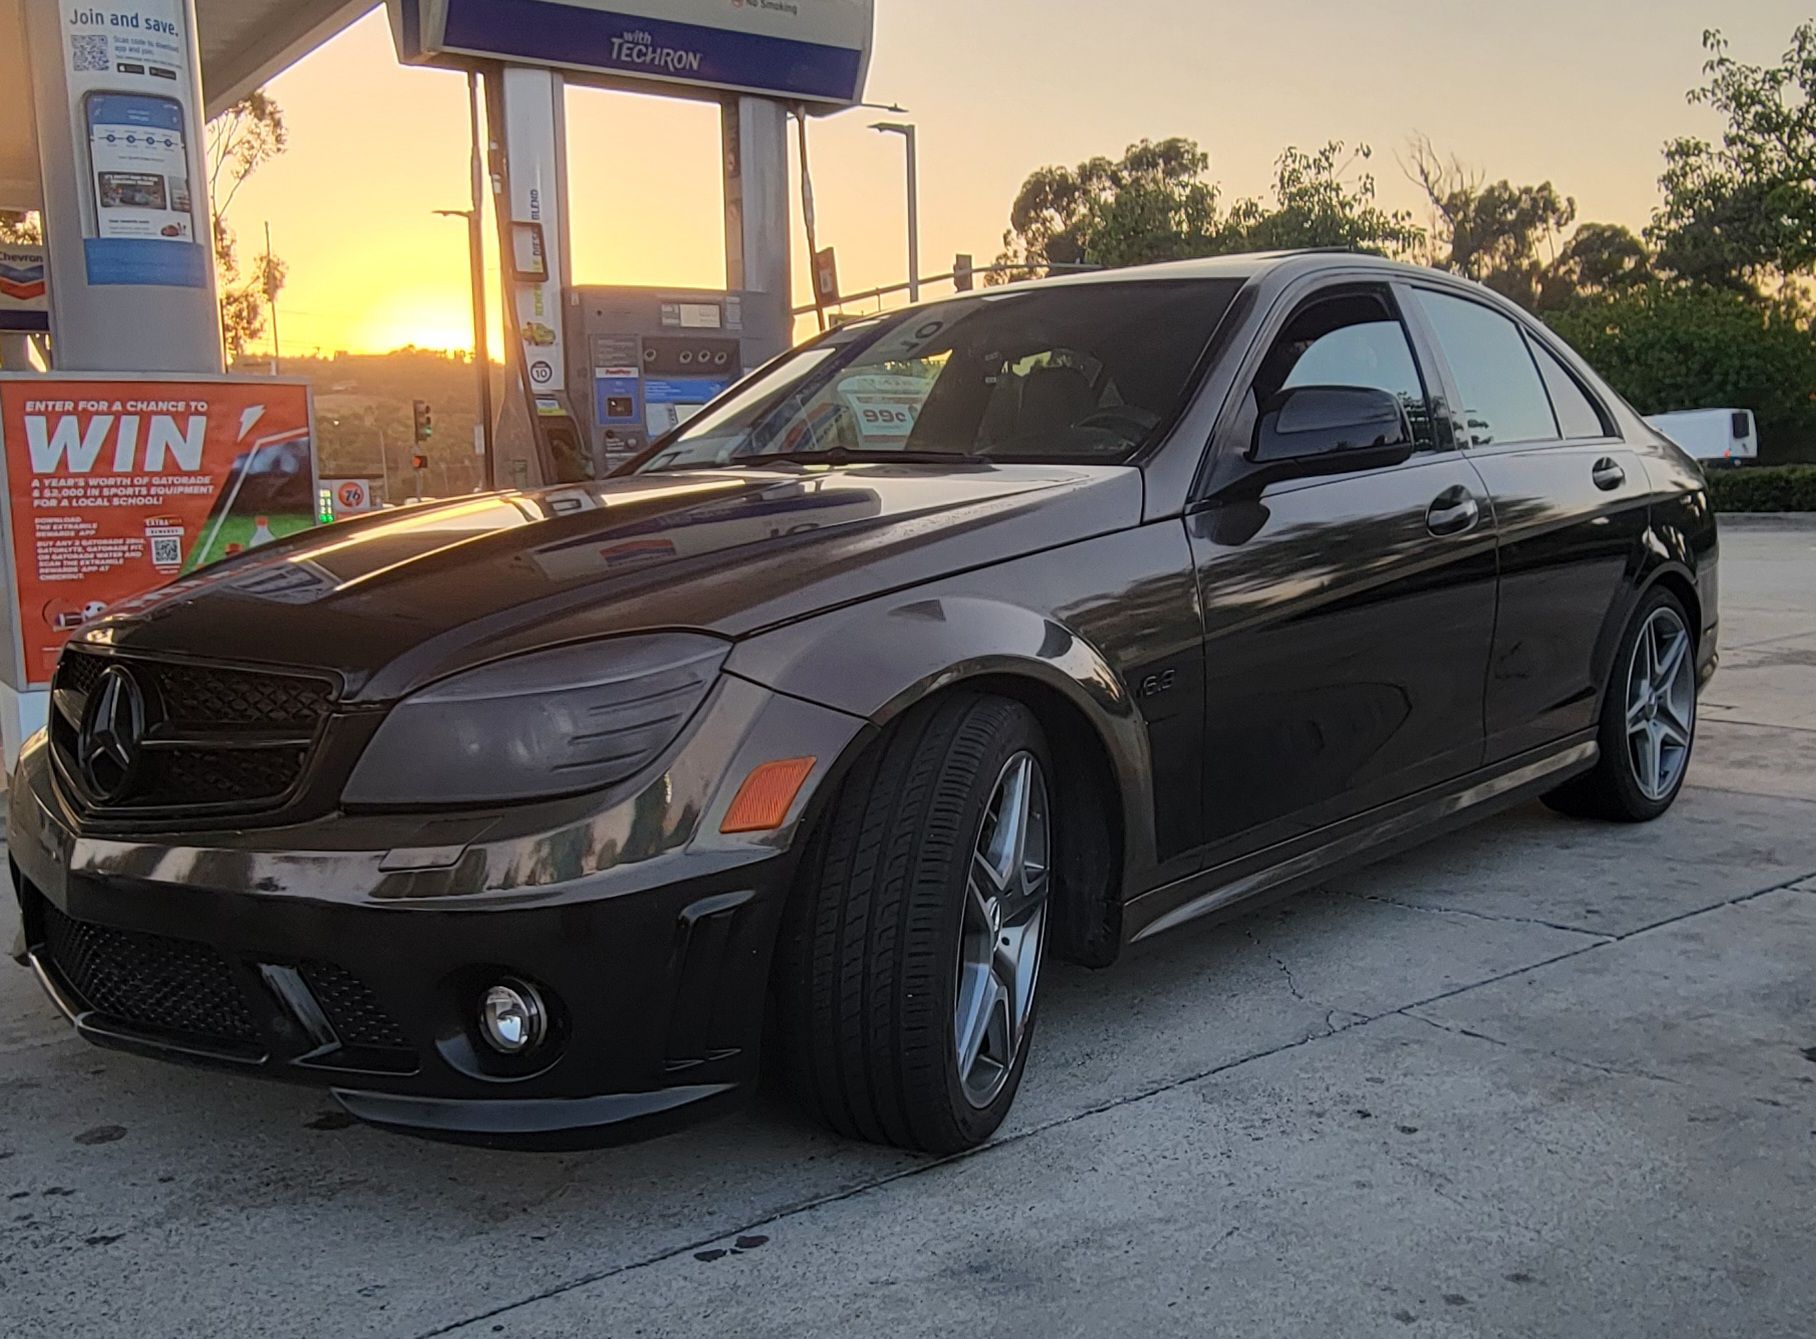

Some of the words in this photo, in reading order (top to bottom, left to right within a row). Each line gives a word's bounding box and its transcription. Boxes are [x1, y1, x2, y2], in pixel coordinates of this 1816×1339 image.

[70, 8, 105, 25] Join
[110, 12, 139, 28] and
[145, 17, 179, 37] save.
[623, 30, 652, 44] with
[610, 37, 701, 72] TECHRON
[530, 189, 540, 220] BLEND
[535, 369, 547, 378] 10
[25, 401, 74, 412] ENTER
[78, 401, 108, 412] FOR
[112, 401, 122, 412] A
[126, 401, 186, 412] CHANCE
[189, 401, 208, 412] TO
[24, 414, 207, 473] WIN
[31, 478, 40, 487] A
[43, 478, 85, 487] YEAR'S
[88, 477, 131, 486] WORTH
[133, 477, 148, 486] OF
[151, 476, 212, 485] GATORADE
[87, 487, 100, 496] IN
[103, 486, 147, 496] SPORTS
[150, 485, 214, 495] EQUIPMENT
[345, 489, 361, 502] 76
[33, 498, 57, 508] FOR
[59, 497, 70, 507] A
[72, 497, 110, 507] LOCAL
[112, 496, 163, 506] SCHOOL!
